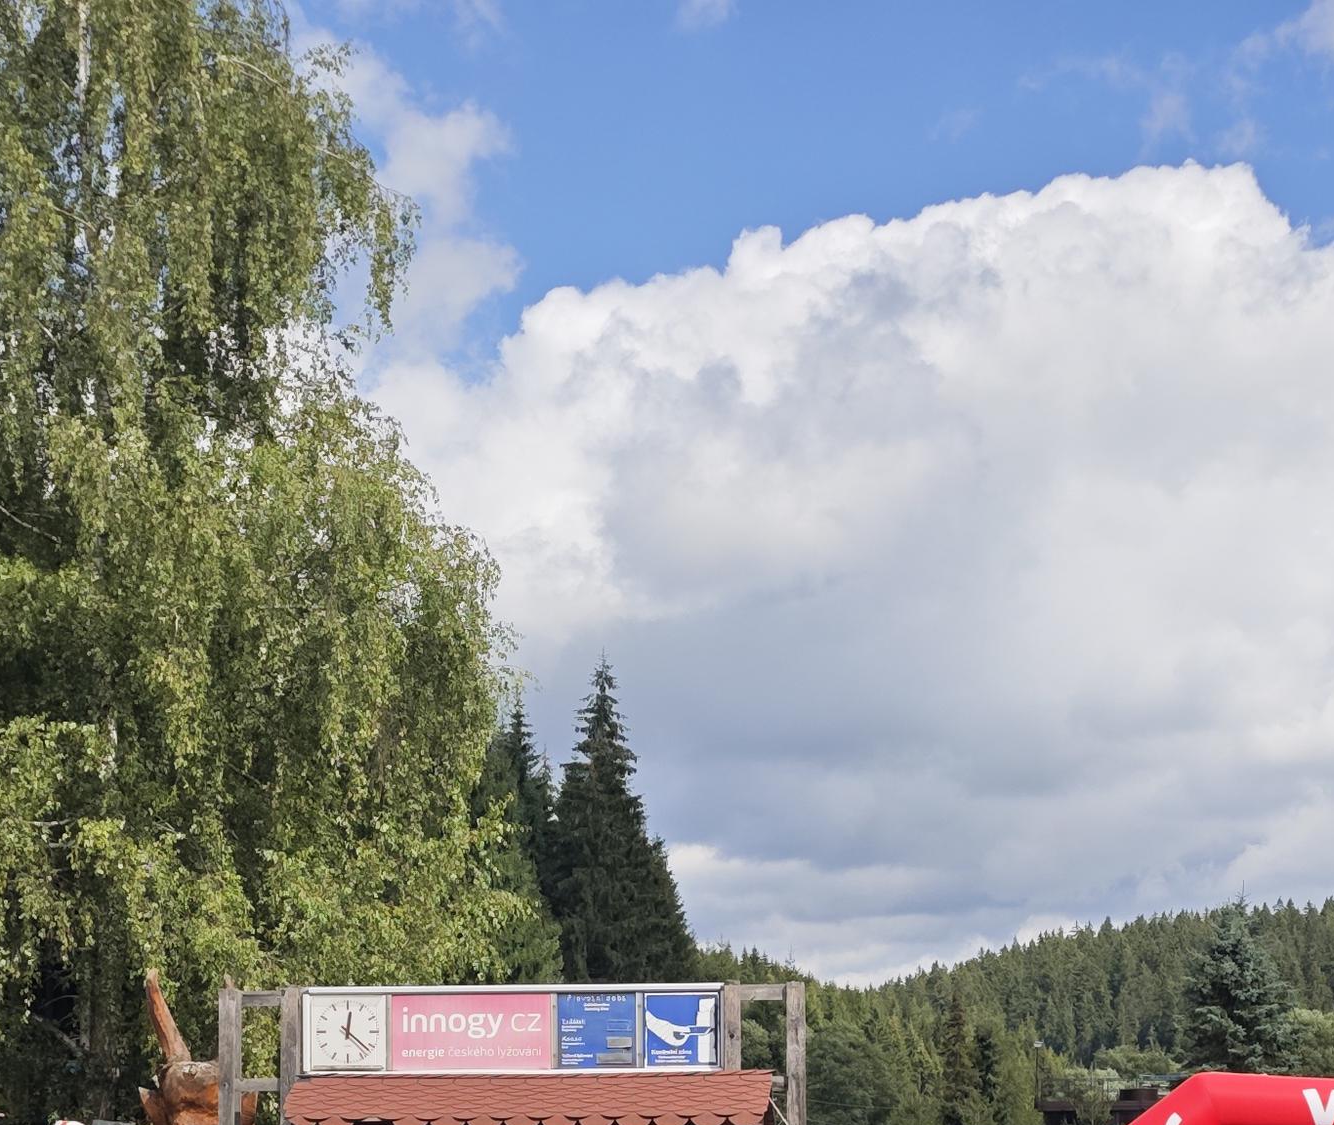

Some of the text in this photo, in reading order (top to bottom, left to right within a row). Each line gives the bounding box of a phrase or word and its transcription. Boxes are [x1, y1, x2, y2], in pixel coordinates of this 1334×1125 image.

[401, 1006, 503, 1039] innogy
[401, 1045, 543, 1060] energie českého lyžování
